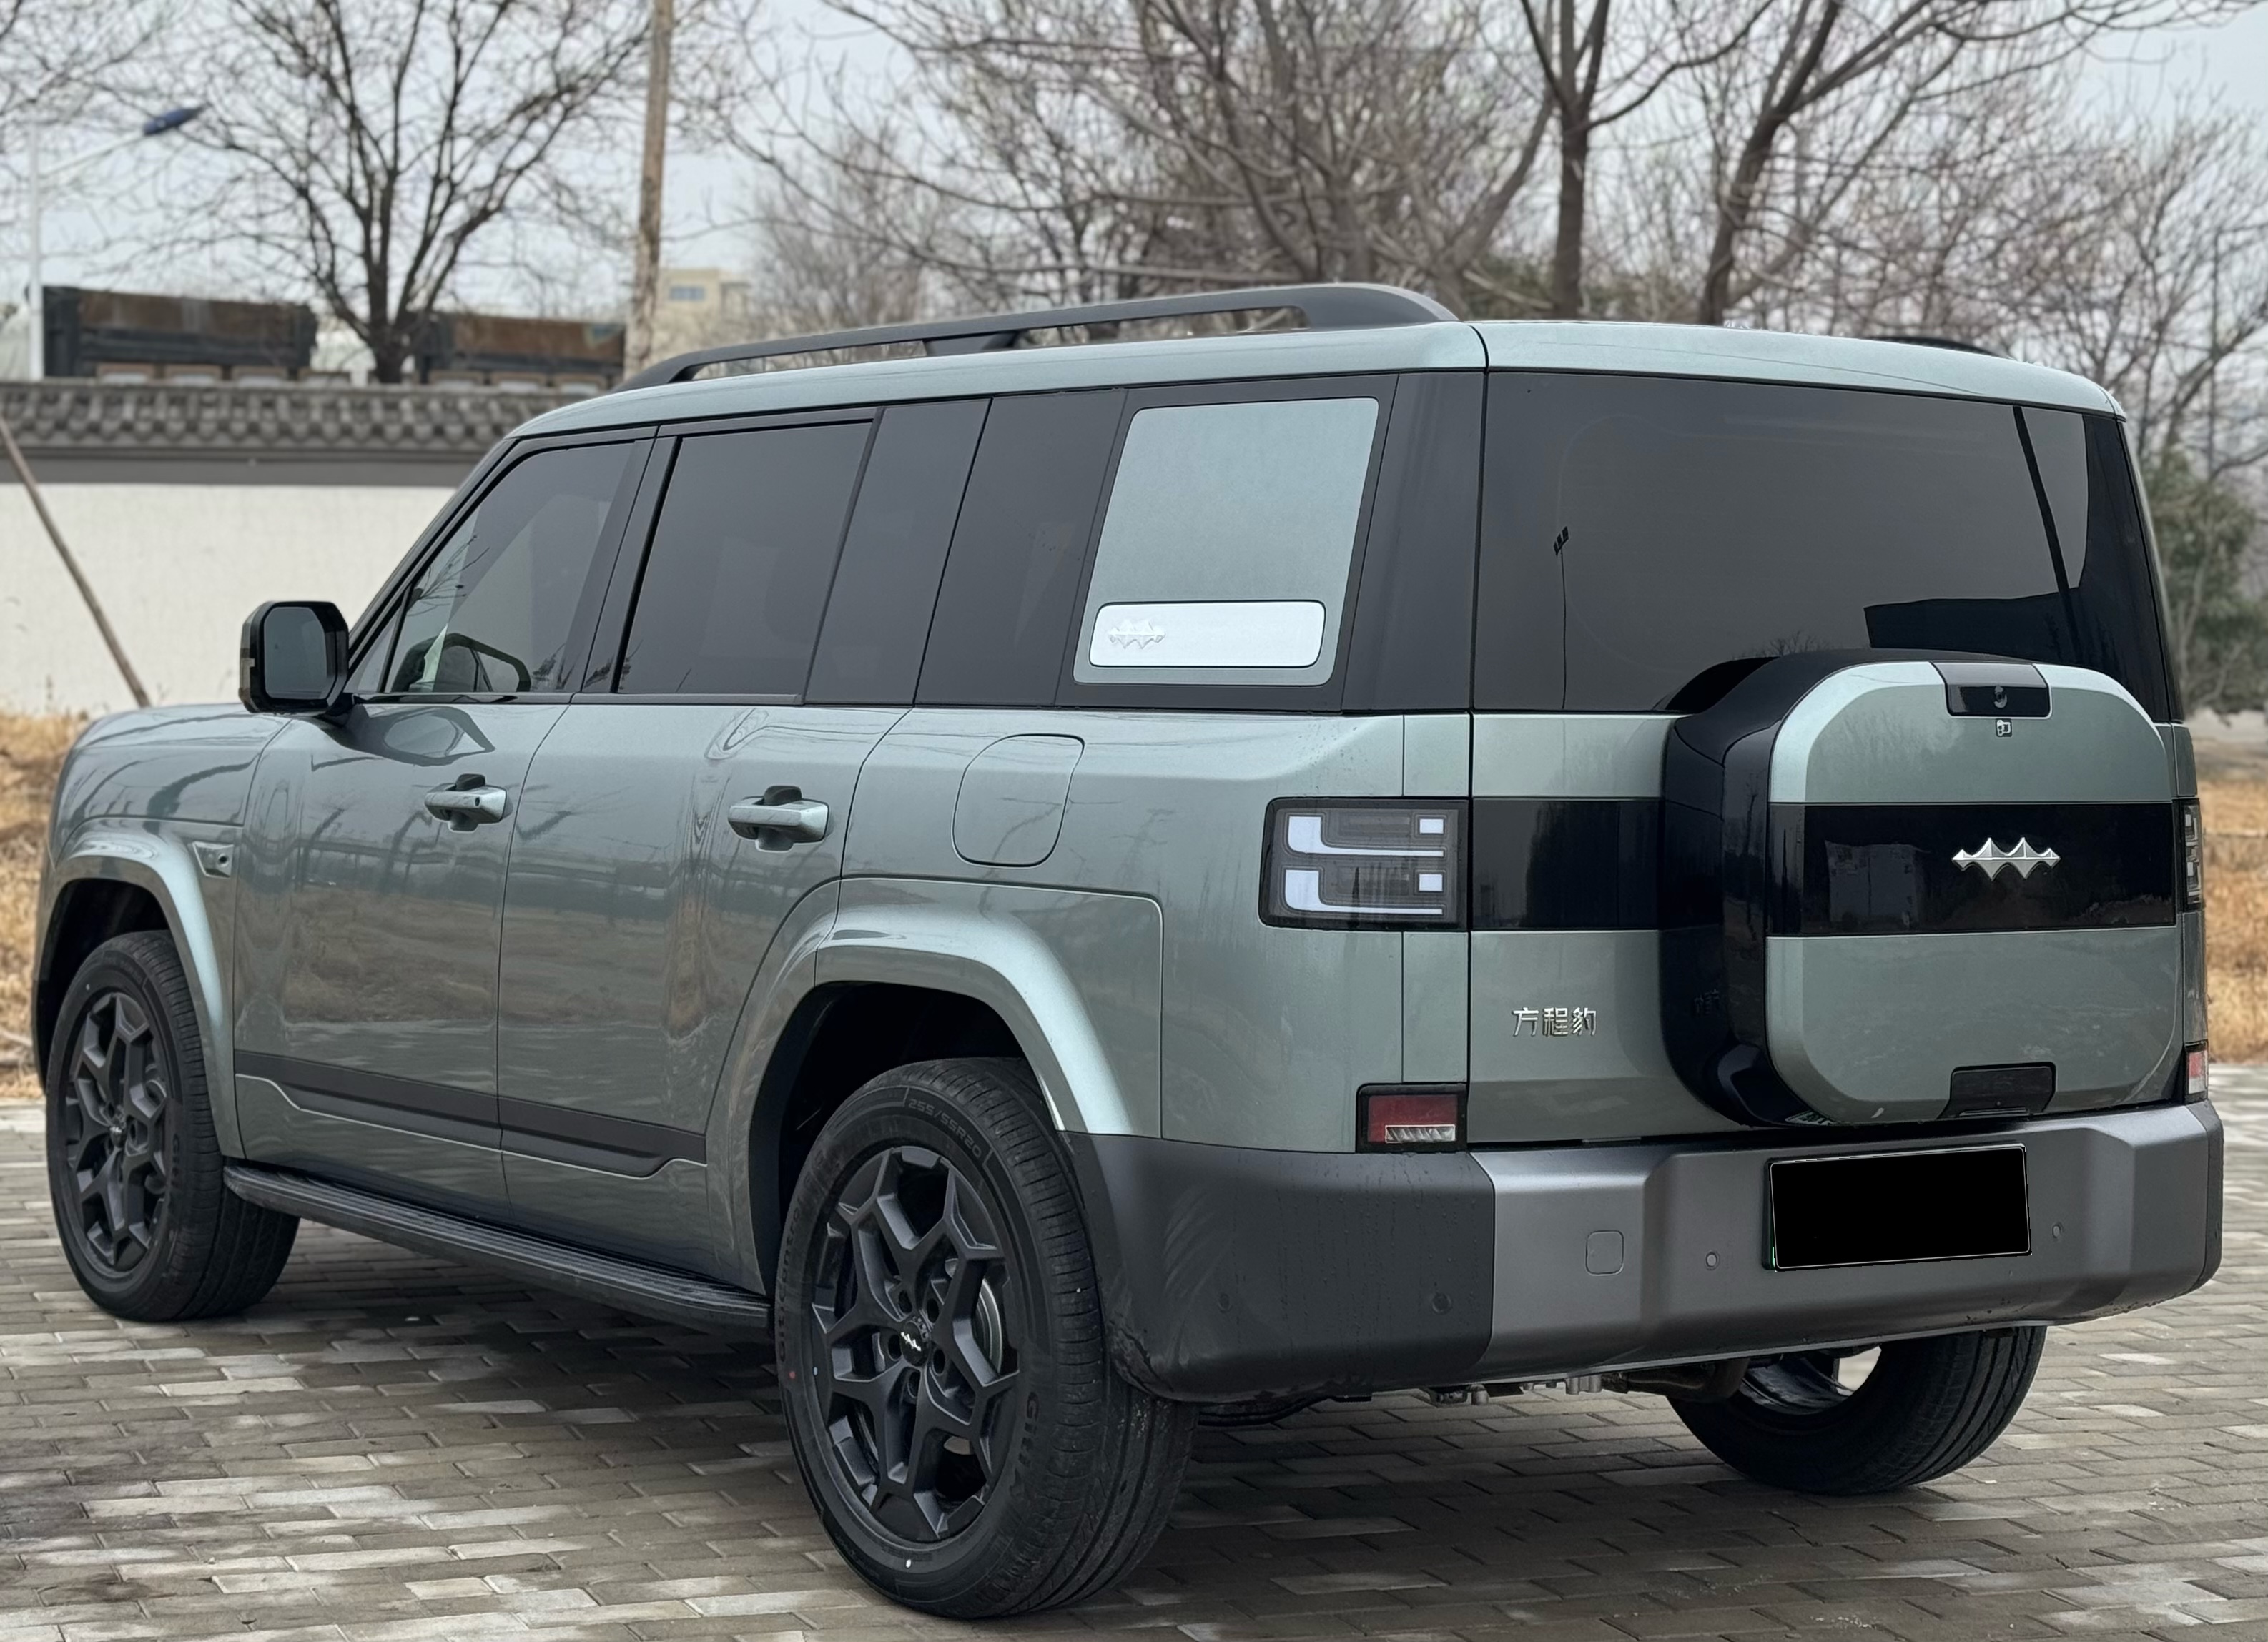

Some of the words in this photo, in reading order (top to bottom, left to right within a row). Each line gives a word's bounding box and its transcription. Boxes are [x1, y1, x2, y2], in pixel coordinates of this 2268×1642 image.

[1512, 1007, 1597, 1037] 方程豹
[908, 1099, 981, 1159] 255/55R20
